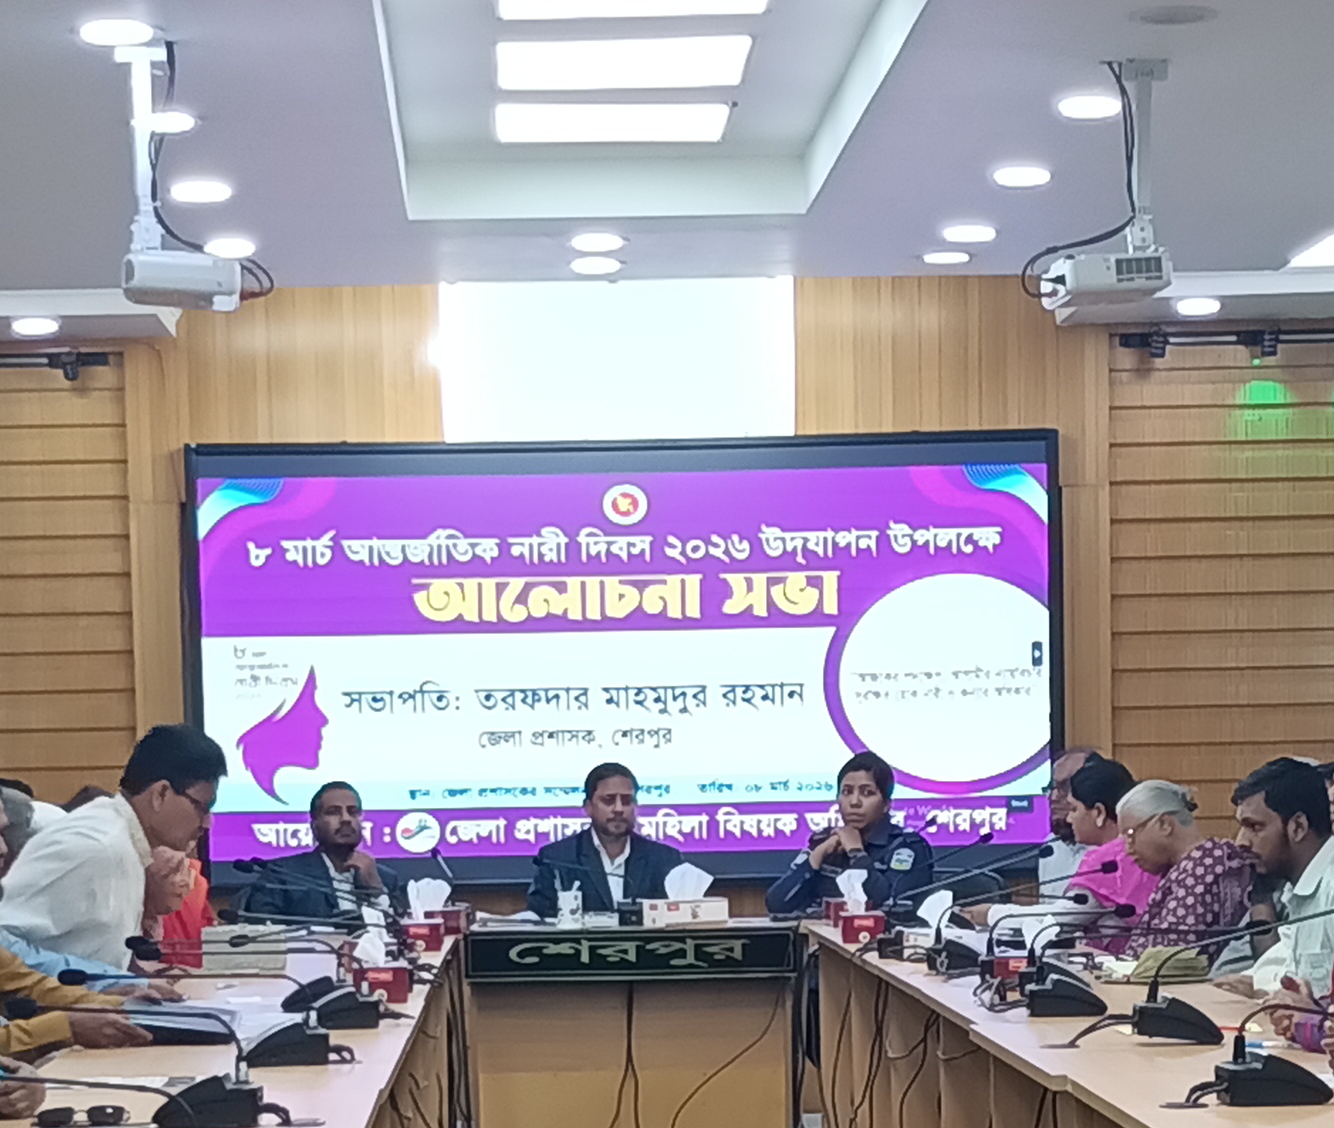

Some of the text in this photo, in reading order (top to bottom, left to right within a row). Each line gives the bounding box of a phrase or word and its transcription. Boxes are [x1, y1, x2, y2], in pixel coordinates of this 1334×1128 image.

[246, 541, 272, 568] ৮
[280, 529, 336, 568] মার্চ
[506, 525, 569, 565] নারী
[575, 527, 654, 564] দিবস
[664, 533, 751, 564] ২০২৬
[886, 520, 1003, 555] উপলক্ষে
[411, 570, 842, 623] আলোচনা সভা
[341, 680, 806, 717] সভাপতি: তরফদার মাহমুদুর রহমান
[478, 730, 523, 749] জেলা
[611, 727, 673, 749] শেরপুর
[445, 818, 508, 845] জেলা
[513, 815, 593, 844] প্রশাস
[636, 807, 710, 843] মহিলা
[715, 806, 800, 840] বিষয়ক
[508, 937, 751, 968] শেরপুর
